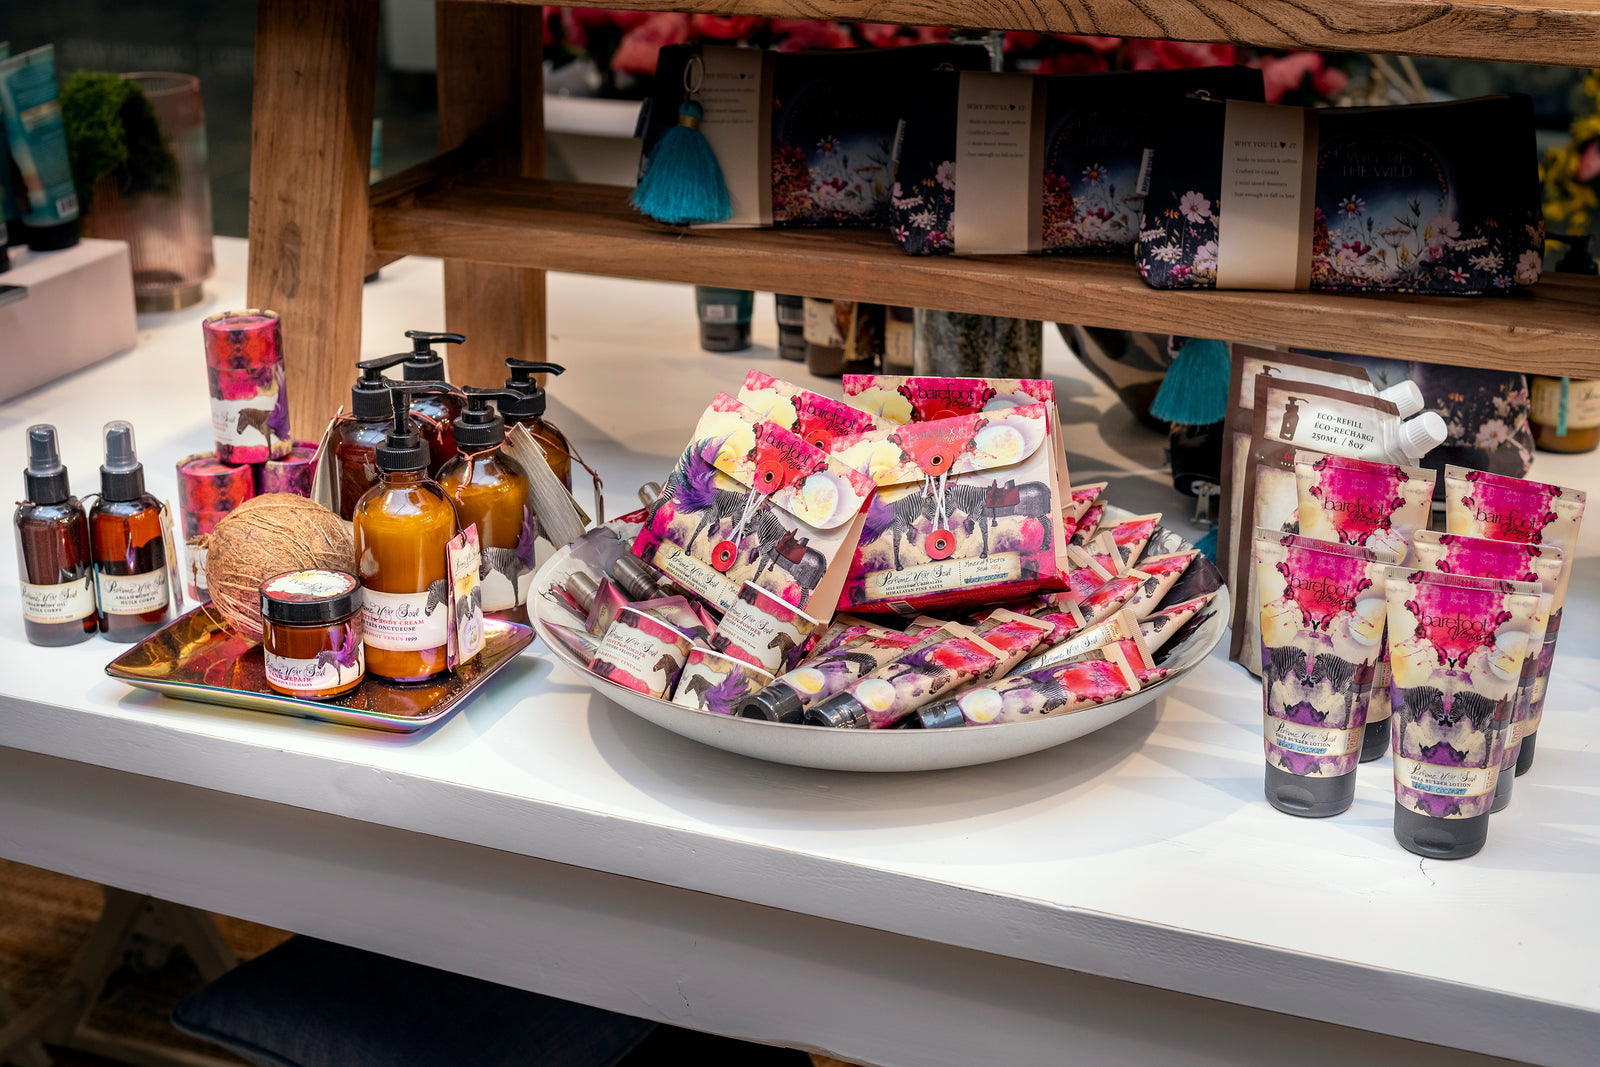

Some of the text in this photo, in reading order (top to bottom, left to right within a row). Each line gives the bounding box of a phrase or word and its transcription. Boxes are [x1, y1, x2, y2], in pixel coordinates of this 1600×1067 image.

[1343, 164, 1413, 177] THE WILD
[918, 382, 974, 402] barefoot
[806, 401, 858, 430] barefoot
[1316, 412, 1364, 430] ECO-REFILL
[908, 422, 966, 442] barefoot
[764, 430, 812, 466] barefoot
[1324, 496, 1384, 518] barefoot
[1476, 507, 1536, 530] barefoot
[666, 546, 689, 570] Perfume
[703, 572, 720, 588] Soul
[878, 570, 910, 587] Perfume
[932, 564, 952, 578] Soul
[886, 587, 914, 596] HIMALAYAN
[1290, 574, 1350, 598] barefoot
[396, 603, 420, 620] Soul
[1420, 610, 1486, 633] barefoot
[757, 618, 774, 635] Soul
[641, 640, 658, 657] Soul
[1040, 653, 1064, 667] Perfume
[1084, 636, 1098, 648] Soul
[304, 664, 326, 679] Soul
[1274, 720, 1298, 736] Perfume
[1318, 731, 1337, 742] Soul
[1409, 762, 1436, 779] Perfume
[1459, 770, 1477, 783] Soul
